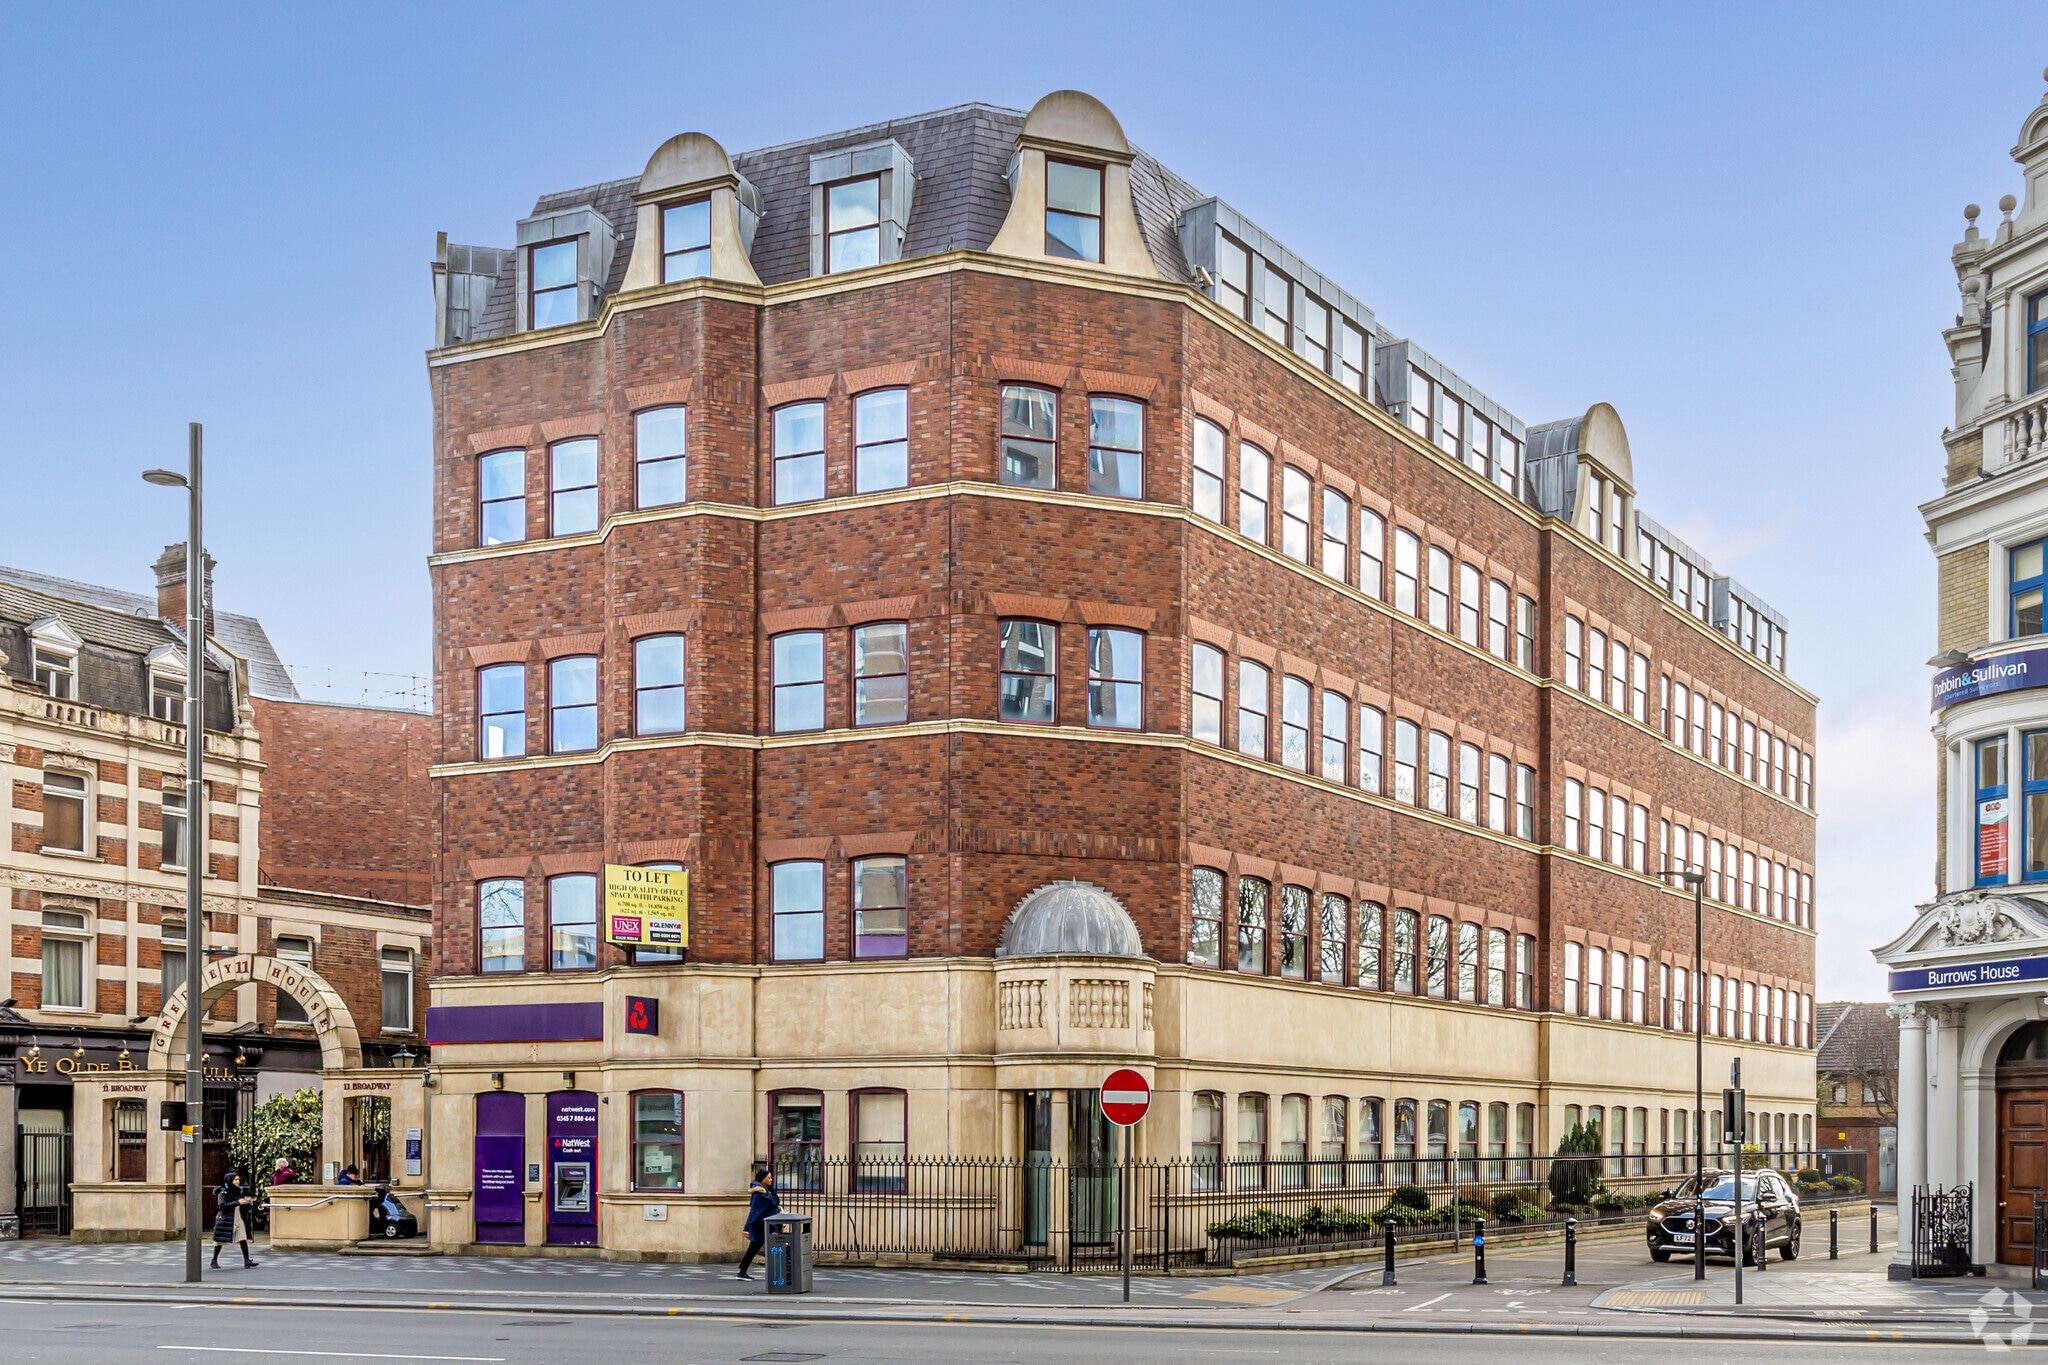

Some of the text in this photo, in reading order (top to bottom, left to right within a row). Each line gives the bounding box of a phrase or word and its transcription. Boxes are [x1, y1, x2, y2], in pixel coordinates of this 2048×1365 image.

[1944, 681, 2000, 700] Chartered Surveyors
[623, 869, 670, 884] TO LET
[608, 883, 685, 896] HIGH QUALITY OFFICE
[610, 891, 683, 903] SPACE WITH PARKING
[614, 920, 640, 931] UNEX
[235, 961, 249, 974] 11
[1928, 965, 2020, 985] Burrows House
[271, 967, 328, 1027] HOUSE
[156, 963, 232, 1047] GREDEY
[102, 1084, 147, 1092] 11 BROADWAY
[352, 1082, 392, 1090] BROADWAY
[562, 1138, 590, 1147] NatWest
